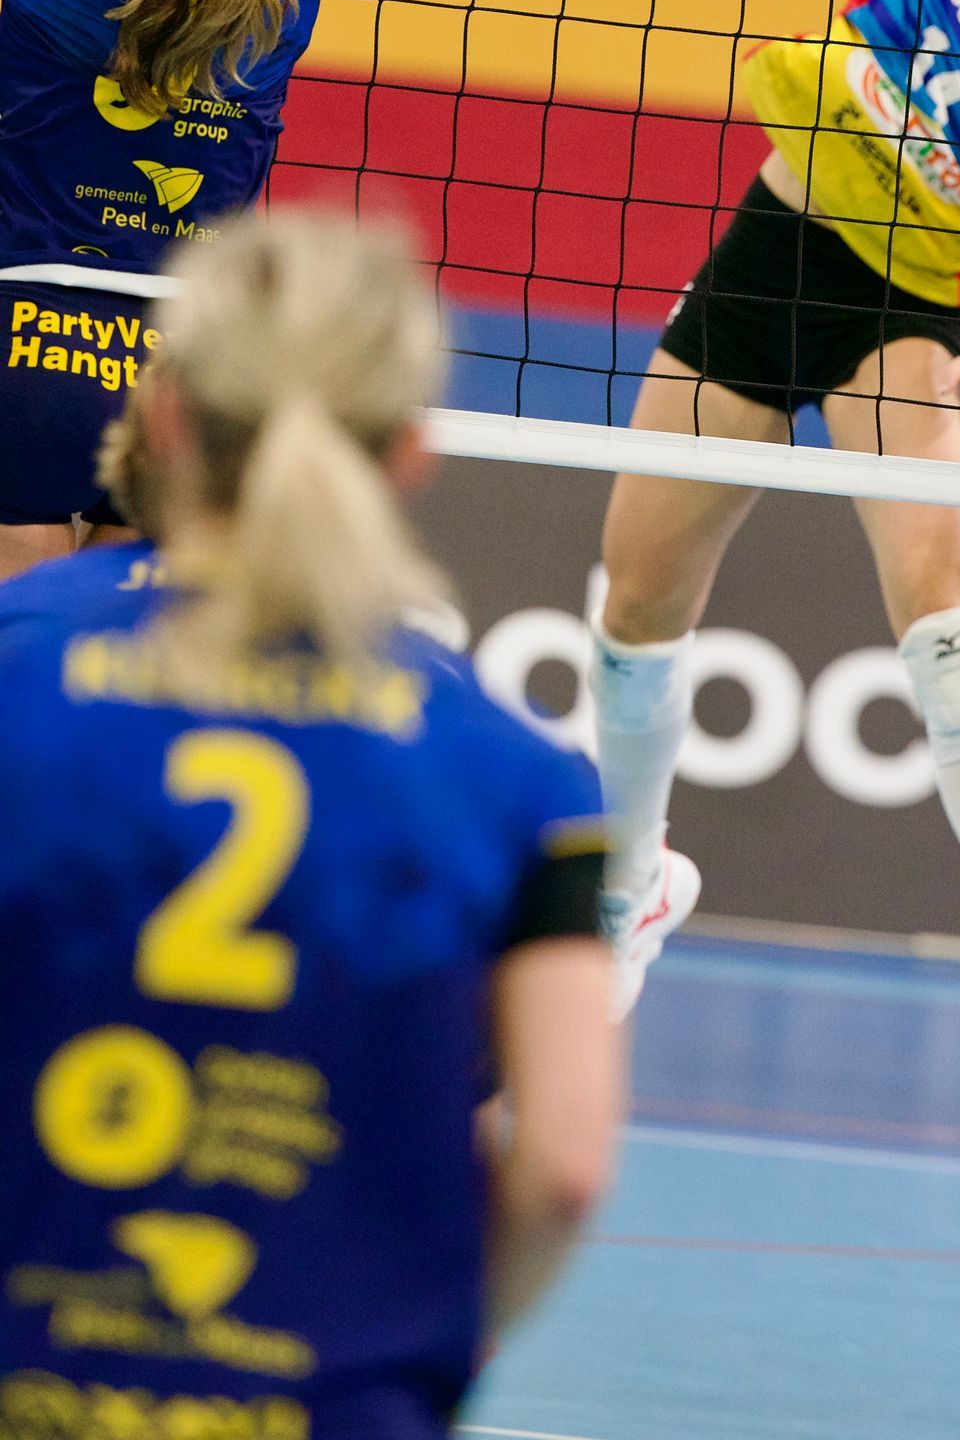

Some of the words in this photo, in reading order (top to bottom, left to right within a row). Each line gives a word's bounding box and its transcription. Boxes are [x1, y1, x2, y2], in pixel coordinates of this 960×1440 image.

[179, 97, 248, 119] graphic
[173, 119, 228, 144] group
[75, 184, 147, 204] gemeente
[102, 207, 147, 230] Peel
[152, 223, 170, 235] en
[11, 301, 165, 351] PartyVe
[7, 335, 150, 392] Hangt
[136, 728, 310, 1010] 2
